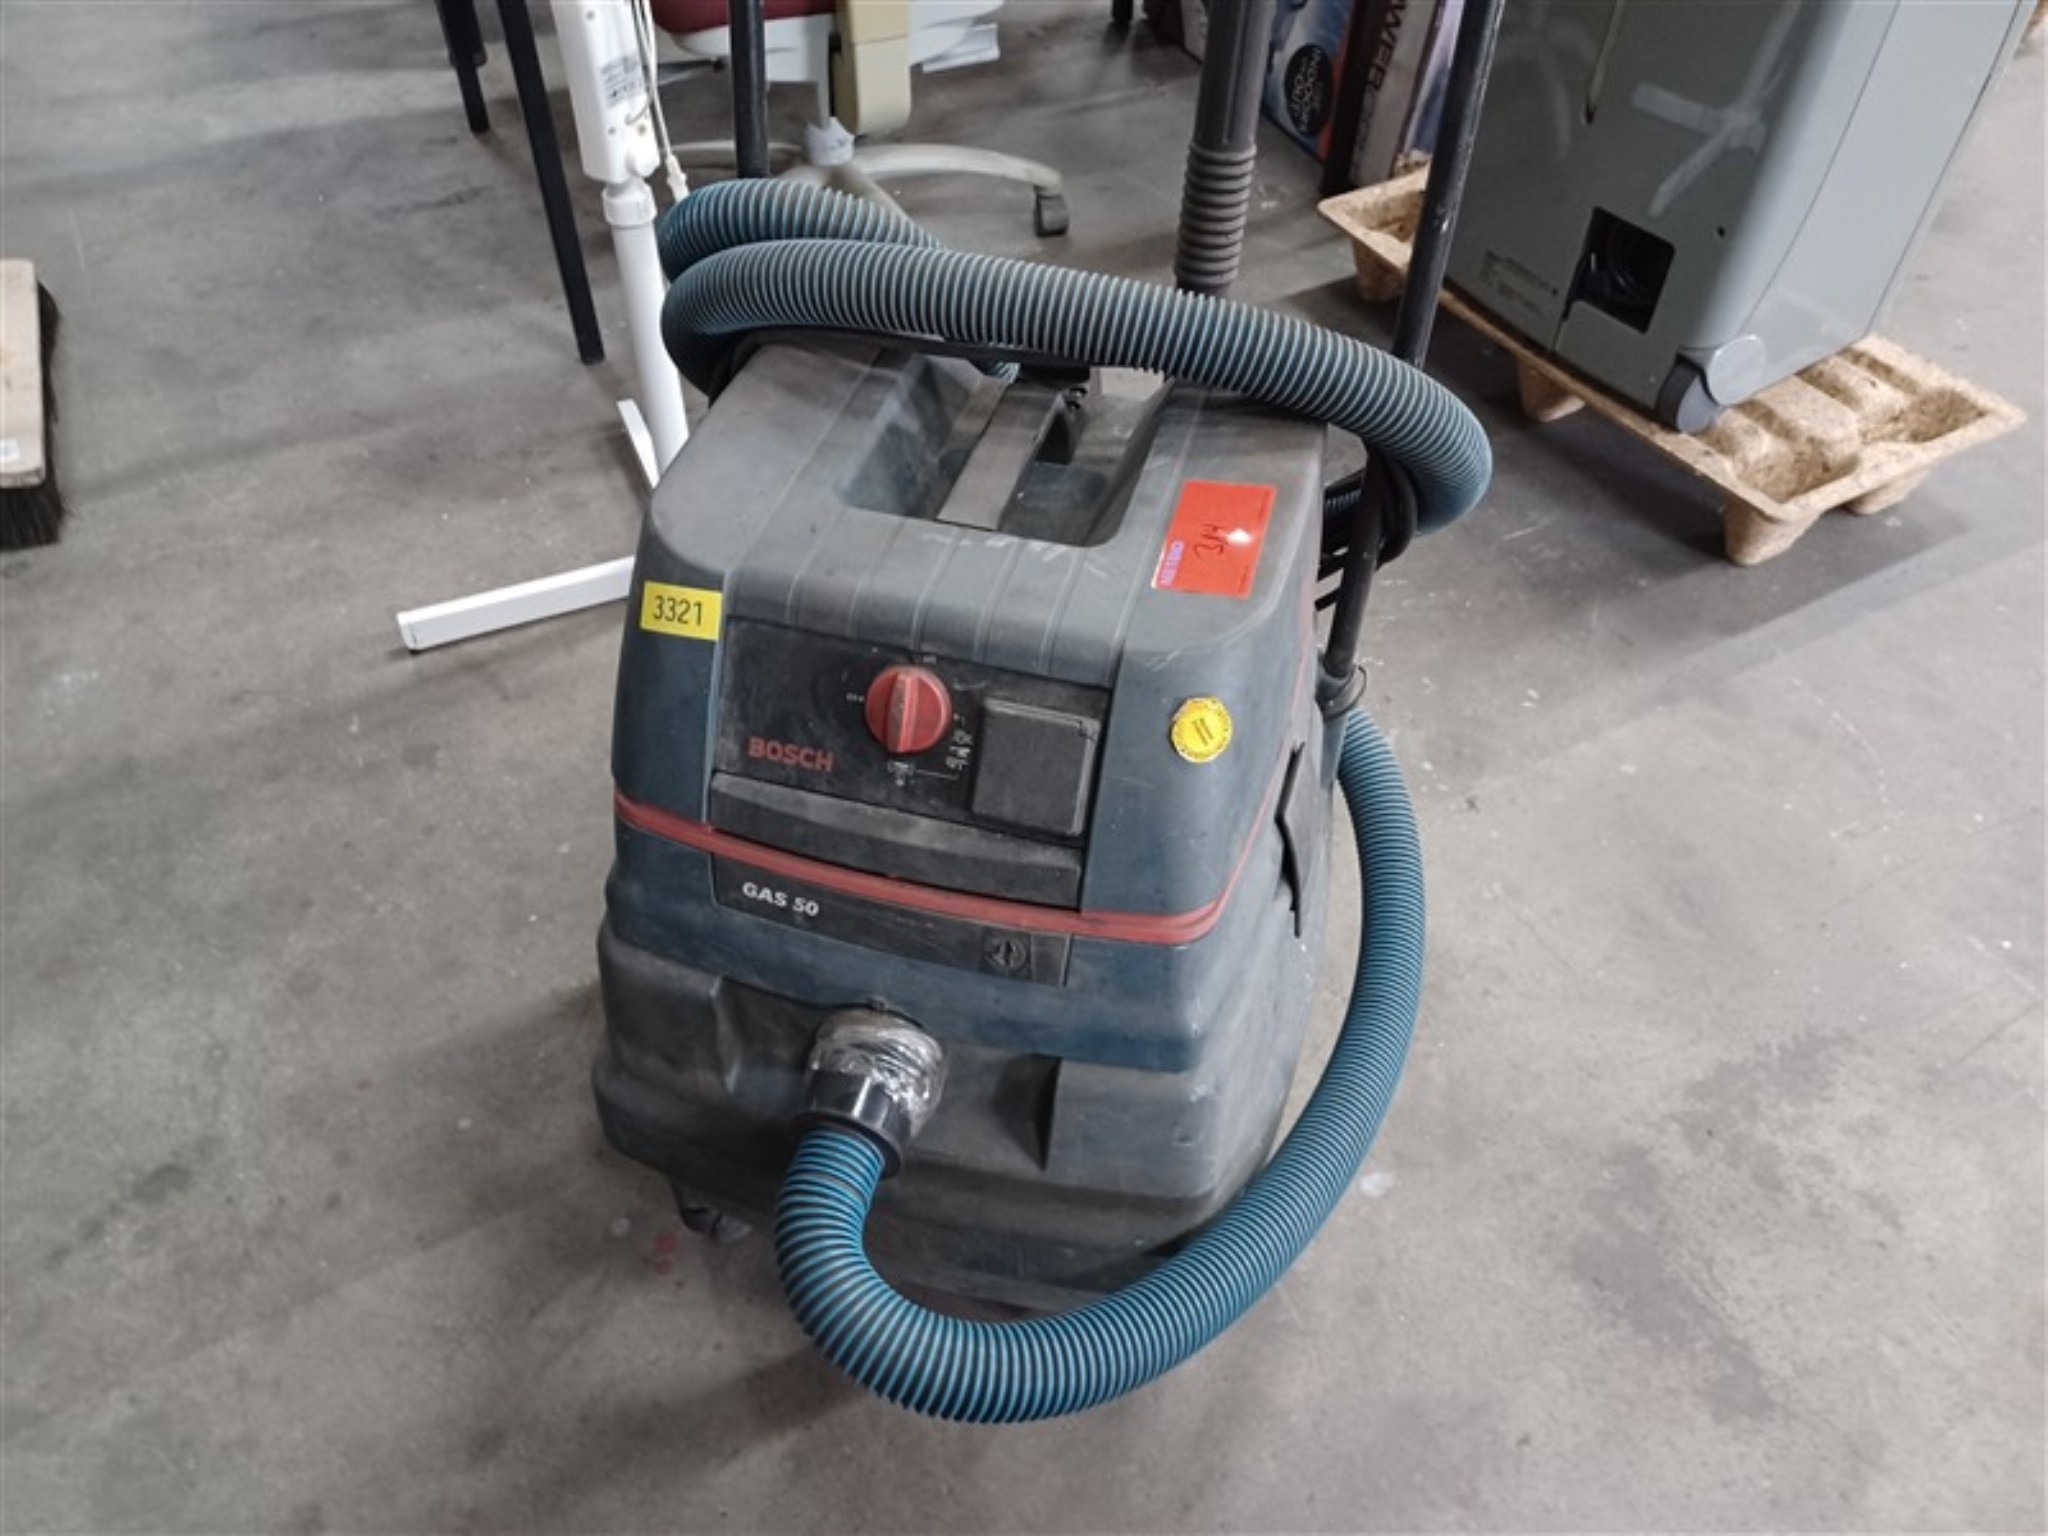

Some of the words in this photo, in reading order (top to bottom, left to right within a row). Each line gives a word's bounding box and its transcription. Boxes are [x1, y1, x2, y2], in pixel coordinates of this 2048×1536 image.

[652, 595, 702, 627] 3321
[748, 736, 834, 773] BOSCH
[741, 880, 788, 908] GAS
[791, 896, 821, 917] 50
